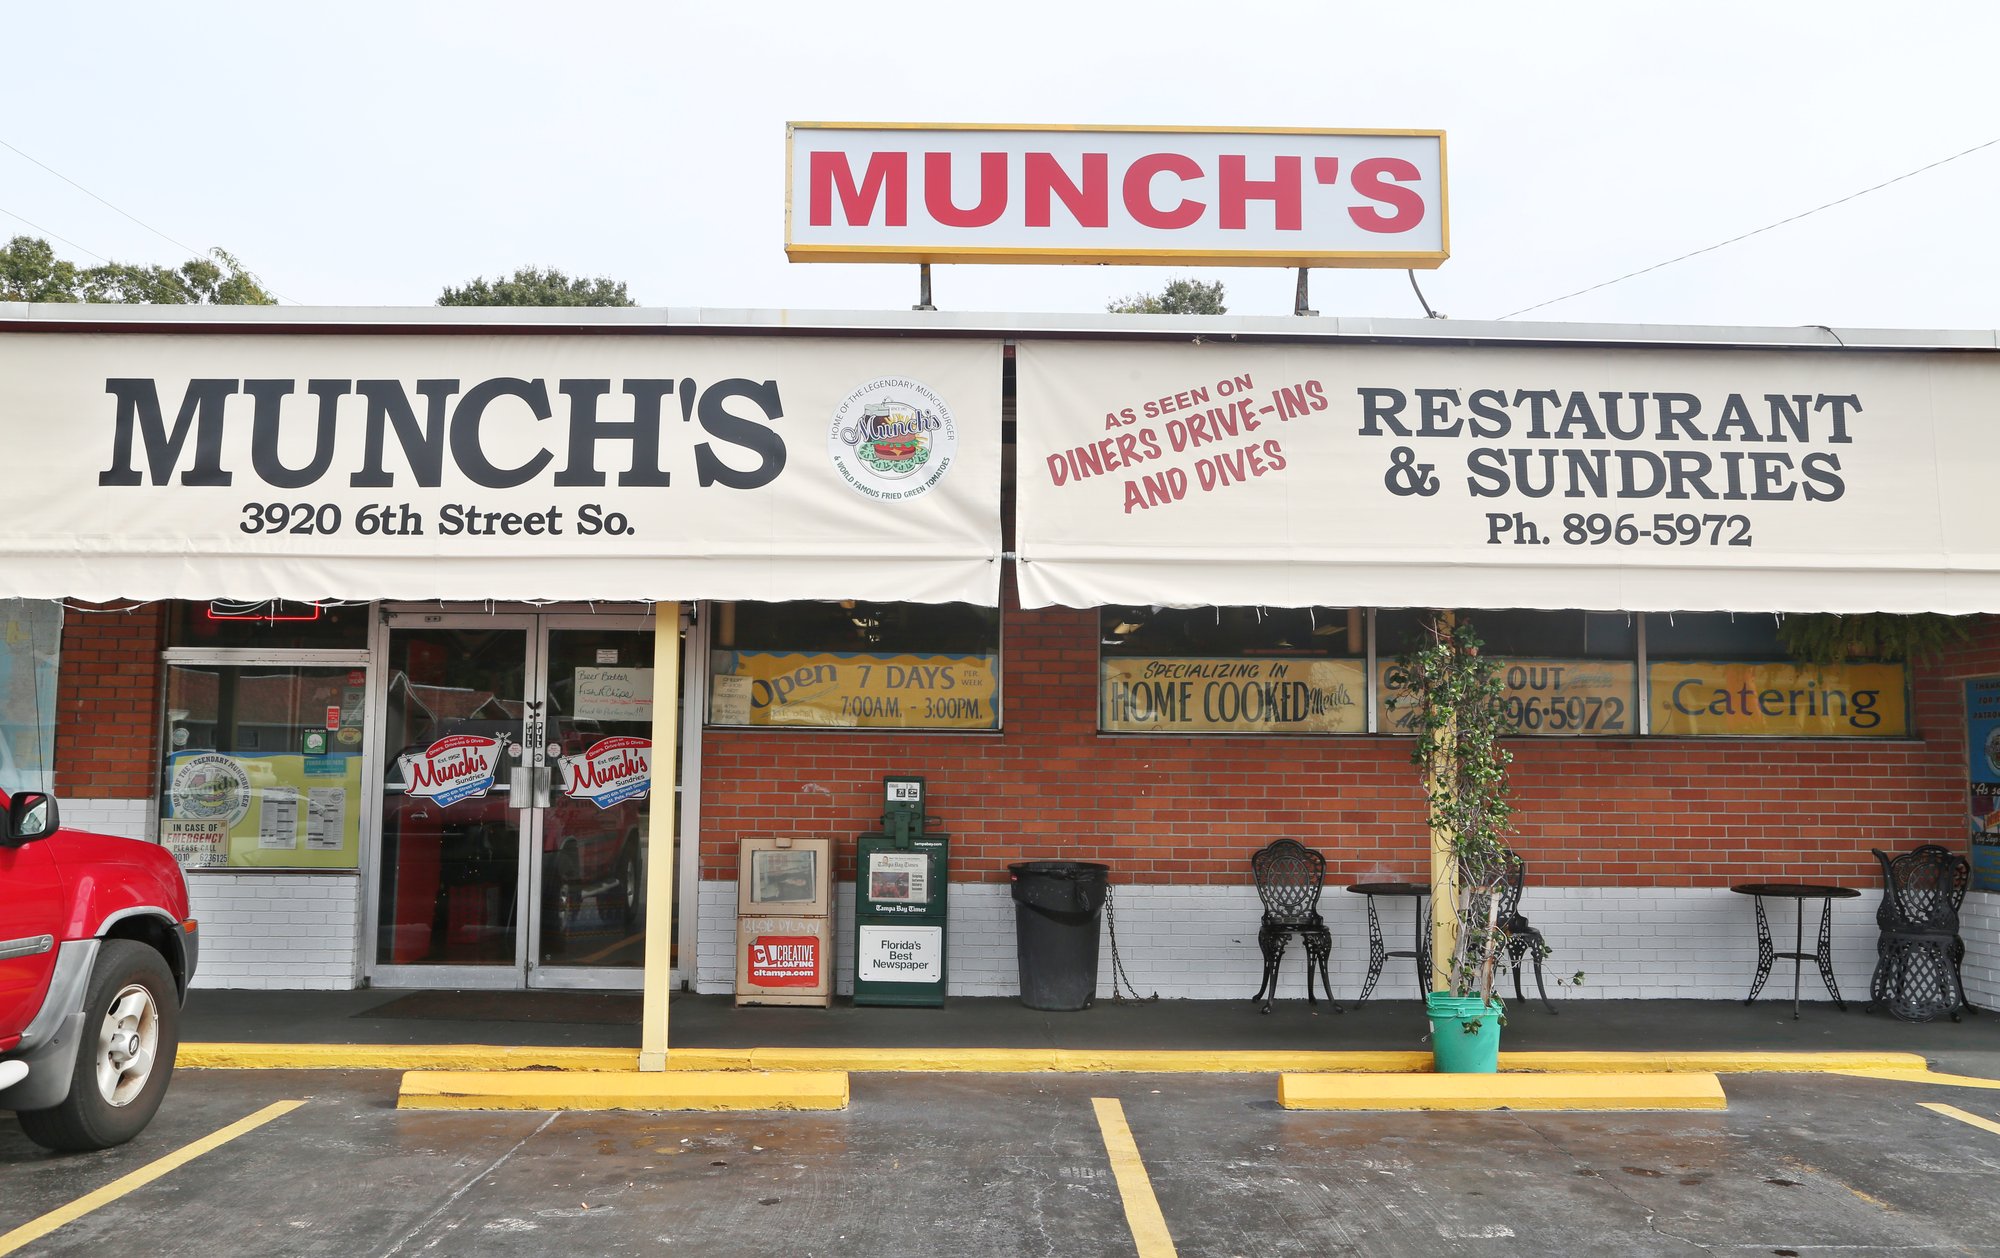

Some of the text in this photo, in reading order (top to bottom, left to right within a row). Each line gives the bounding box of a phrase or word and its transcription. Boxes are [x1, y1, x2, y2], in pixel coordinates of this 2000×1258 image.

[809, 151, 1425, 233] MUNCH'S
[831, 380, 955, 441] HOME OF THE LEGENDARY MUNCHBURGER
[1105, 373, 1254, 430] AS SEEN ON
[1357, 387, 1863, 444] RESTAURANT
[98, 376, 787, 490] MUNCH'S
[840, 409, 942, 446] Munch's
[1046, 380, 1329, 487] DINERS DRIVE-INS
[837, 460, 855, 483] WORLD
[853, 480, 880, 498] FAMOUS
[881, 492, 902, 500] FRIED
[904, 485, 926, 498] GREEN
[925, 457, 951, 488] TOMATOES
[1124, 440, 1287, 514] AND DIVES
[1384, 446, 1847, 502] & SUNDRIES
[240, 503, 635, 537] 3920 6th Street So.
[1485, 512, 1753, 548] Ph. 896-5972
[751, 664, 955, 709] Open 7 DAYS
[961, 678, 983, 686] WEEK
[1143, 661, 1289, 679] SPECIALIZING IN
[1507, 666, 1565, 690] OUT
[1112, 681, 1194, 722] HOME
[1203, 681, 1309, 723] COOKED
[1673, 677, 1881, 729] Catering
[174, 779, 181, 787] OF
[180, 768, 191, 779] THE
[190, 756, 229, 768] LEGENDARY
[406, 747, 488, 793] Munch's
[455, 773, 485, 785] Sundries
[565, 748, 648, 795] Munch's
[615, 774, 645, 787] Sundries
[166, 833, 224, 843] EMERGENCY
[173, 824, 181, 832] IN
[185, 824, 205, 832] CASE
[174, 844, 198, 852] PLEASE
[876, 905, 895, 913] Tampa
[777, 945, 814, 961] CREATIVE
[881, 940, 921, 950] Florida's
[889, 951, 913, 960] Best
[754, 969, 814, 977] cltampa.com
[873, 959, 929, 971] Newspaper
